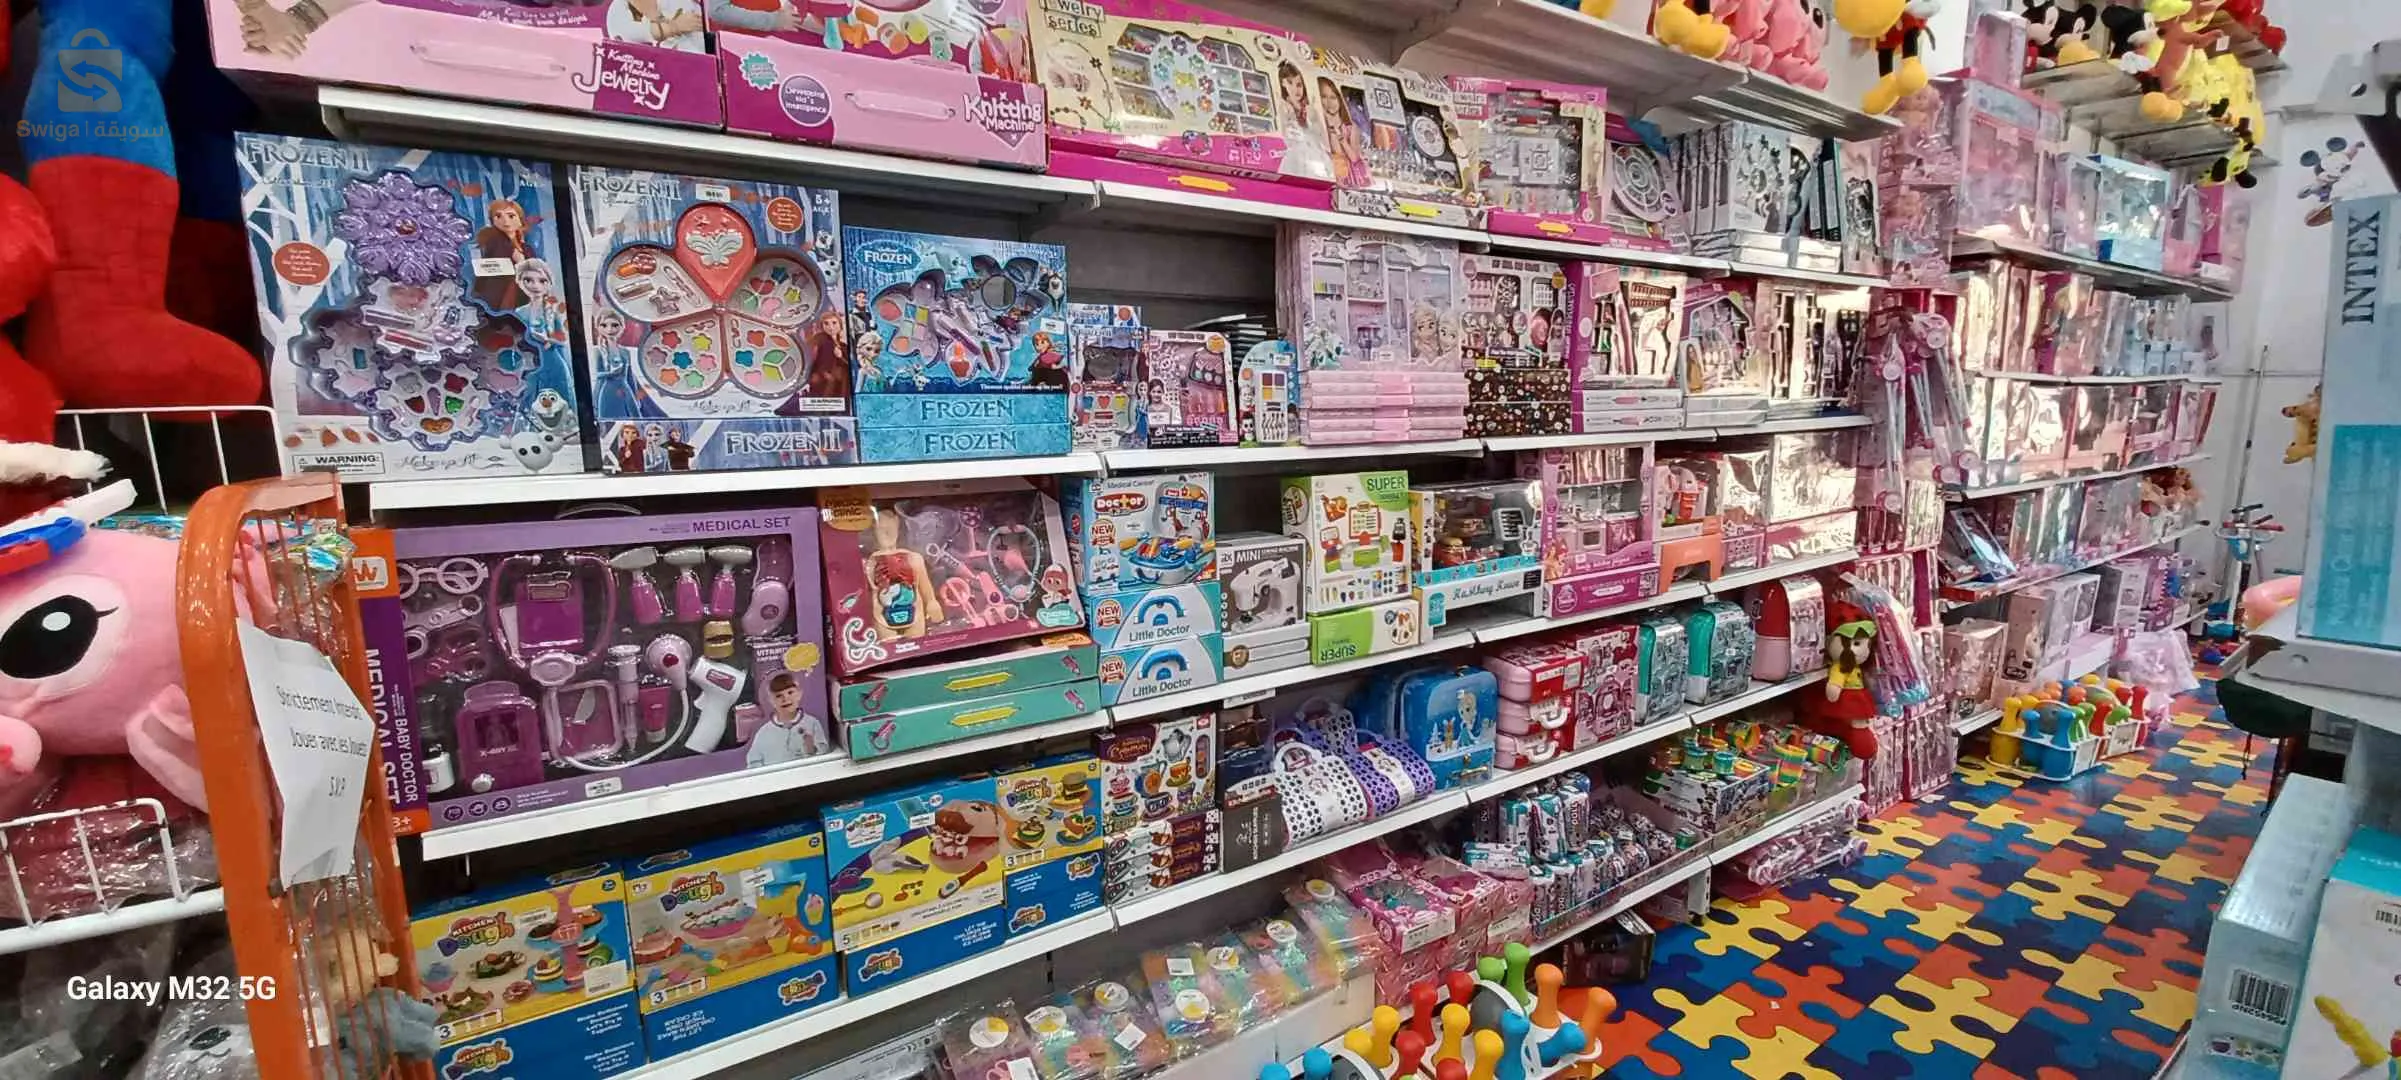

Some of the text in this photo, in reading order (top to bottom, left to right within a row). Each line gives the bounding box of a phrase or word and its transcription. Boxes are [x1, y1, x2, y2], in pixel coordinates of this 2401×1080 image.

[1047, 15, 1098, 37] series
[573, 54, 670, 110] Jewelry
[963, 94, 1042, 122] Knitting
[241, 137, 374, 175] FROZEN II
[577, 170, 661, 197] FROZEN
[863, 249, 912, 265] FROZEN
[2342, 210, 2381, 327] INTEX
[921, 400, 1015, 420] FROZEN
[724, 429, 842, 455] FROZEN II
[924, 431, 1018, 454] FROZEN
[315, 455, 379, 464] WARNING:
[1366, 476, 1406, 491] SUPER
[692, 518, 761, 533] MEDICAL
[764, 516, 791, 529] SET
[1091, 524, 1114, 535] NEW
[1236, 550, 1260, 563] MINI
[1097, 605, 1120, 617] NEW
[1129, 624, 1190, 642] Little Doctor
[1320, 644, 1357, 662] SUPER
[1101, 661, 1123, 673] NEW
[1132, 677, 1192, 697] Little Doctor
[394, 716, 419, 803] BABY DOCTOR
[1007, 856, 1014, 866] 3
[669, 877, 708, 895] KITCHEN
[452, 917, 496, 937] KITCHEN
[842, 934, 850, 946] 5
[653, 991, 664, 1004] 3
[439, 1025, 451, 1039] 3
